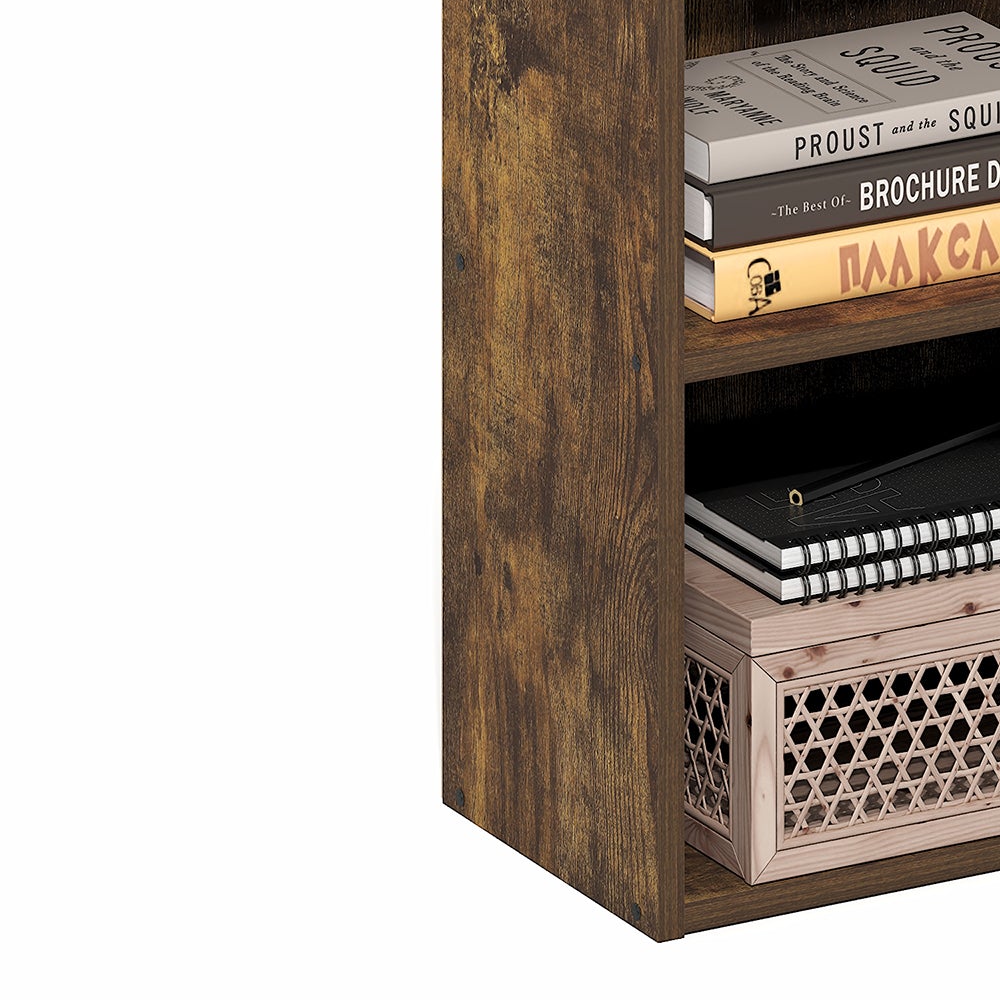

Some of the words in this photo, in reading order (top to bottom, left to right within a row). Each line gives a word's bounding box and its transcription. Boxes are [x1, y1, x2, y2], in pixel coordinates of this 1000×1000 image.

[839, 46, 940, 87] SQUID
[909, 46, 947, 60] and
[935, 56, 964, 72] the
[774, 54, 794, 65] The
[791, 63, 818, 77] Story
[814, 75, 839, 86] and
[832, 85, 869, 104] Science
[777, 73, 816, 95] Reading
[812, 92, 841, 107] Brain
[704, 90, 784, 126] MARYANNE
[795, 121, 884, 161] PROUST
[892, 121, 914, 135] and
[918, 118, 937, 131] the
[859, 162, 981, 212] BROCHURE
[803, 200, 827, 213] Best
